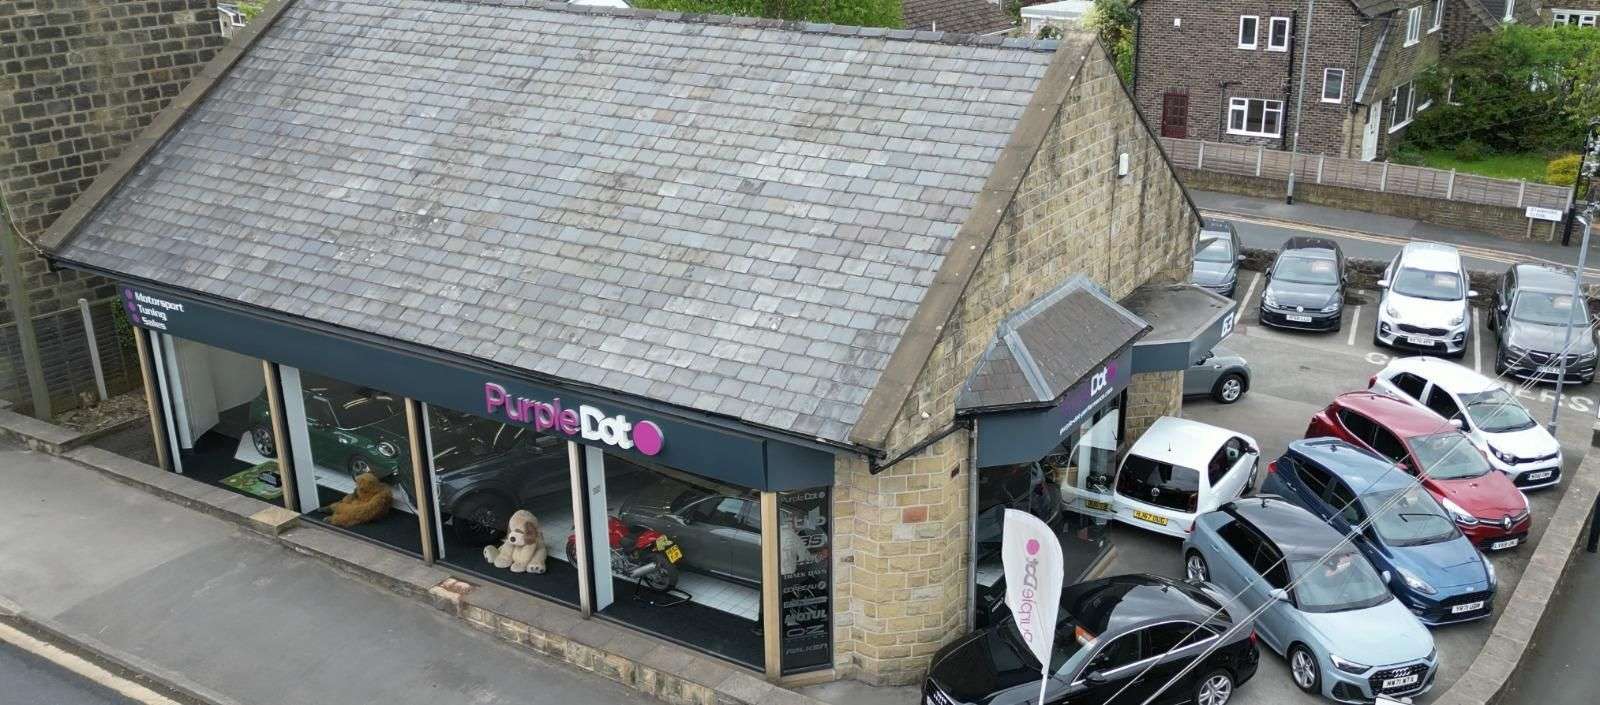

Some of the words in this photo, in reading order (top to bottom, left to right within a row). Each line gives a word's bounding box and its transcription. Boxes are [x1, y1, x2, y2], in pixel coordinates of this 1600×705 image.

[134, 291, 185, 312] Motorsport
[137, 303, 168, 322] Tuning
[141, 316, 168, 330] Sales
[1220, 311, 1235, 338] 63
[484, 382, 634, 450] PurpleDot
